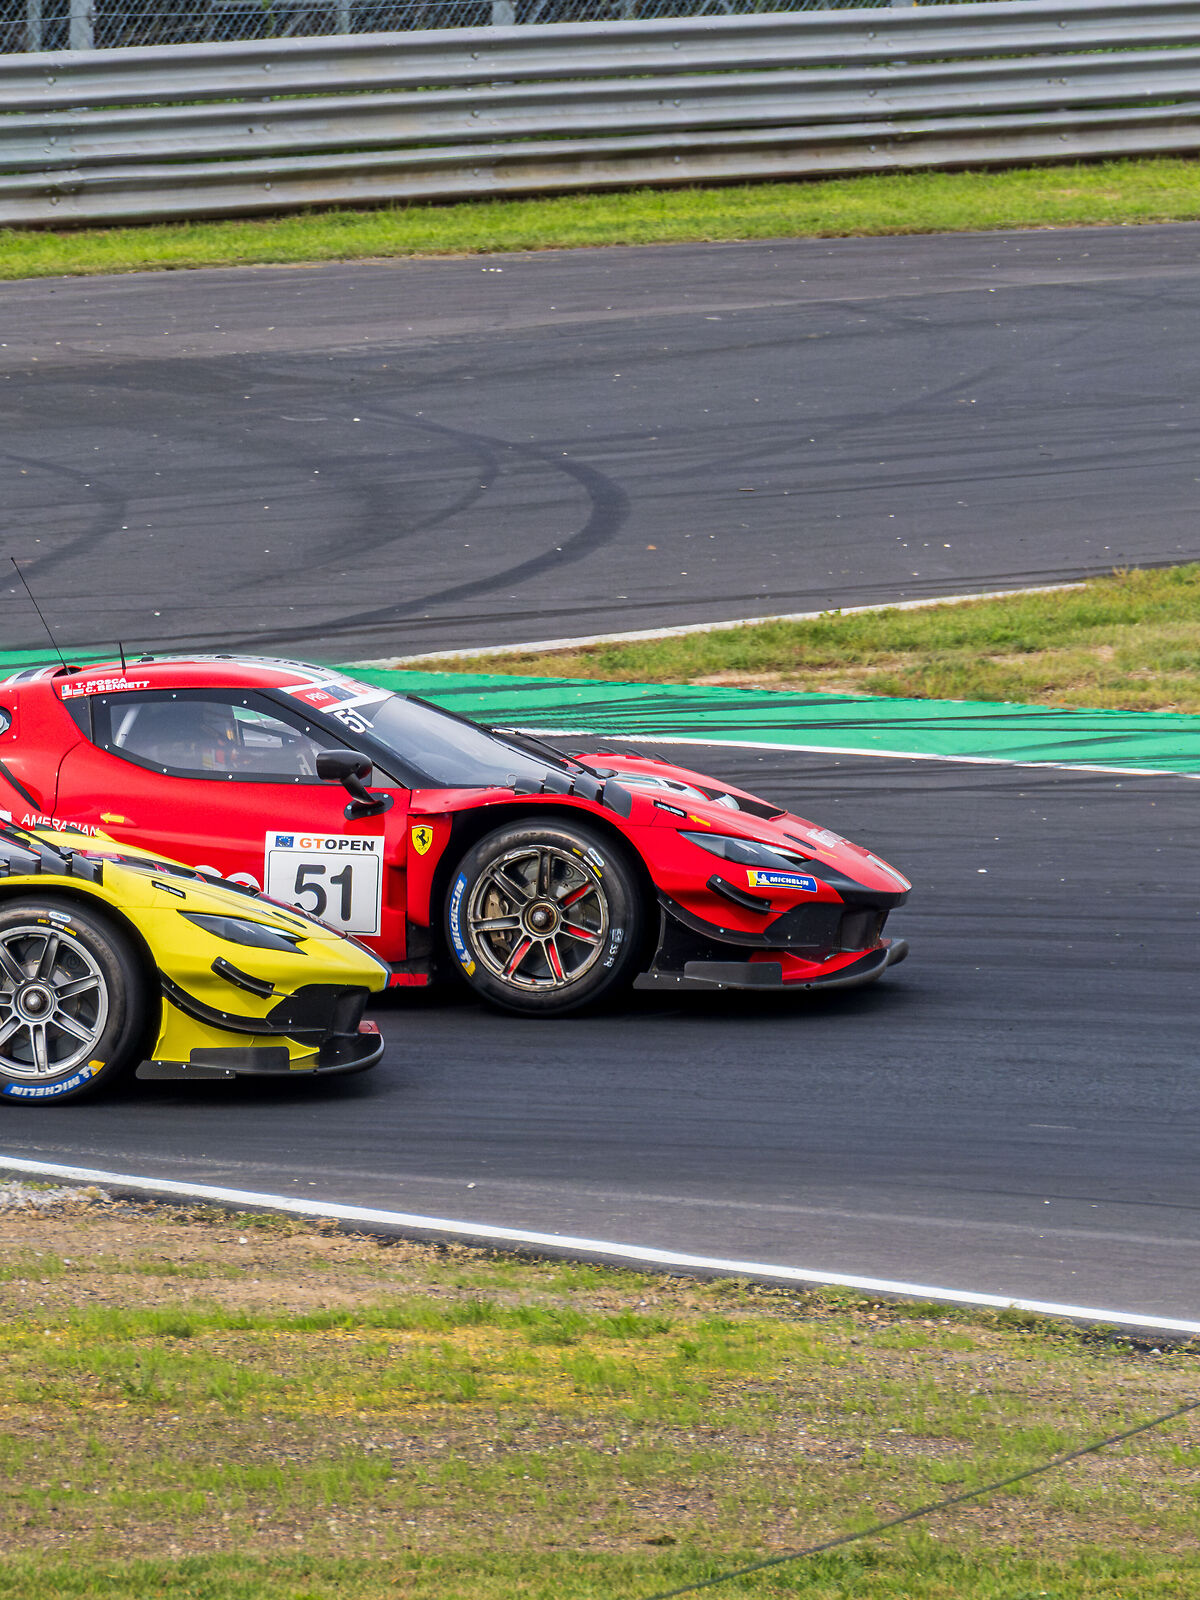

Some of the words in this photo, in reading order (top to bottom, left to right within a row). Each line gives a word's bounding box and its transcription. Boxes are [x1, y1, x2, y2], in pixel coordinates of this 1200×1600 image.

[86, 677, 127, 688] MOSCA
[97, 680, 150, 692] BENNETT
[333, 706, 375, 734] 51
[769, 875, 810, 887] MICHELIN
[293, 863, 353, 922] 51
[10, 1075, 81, 1097] MICHELIN
